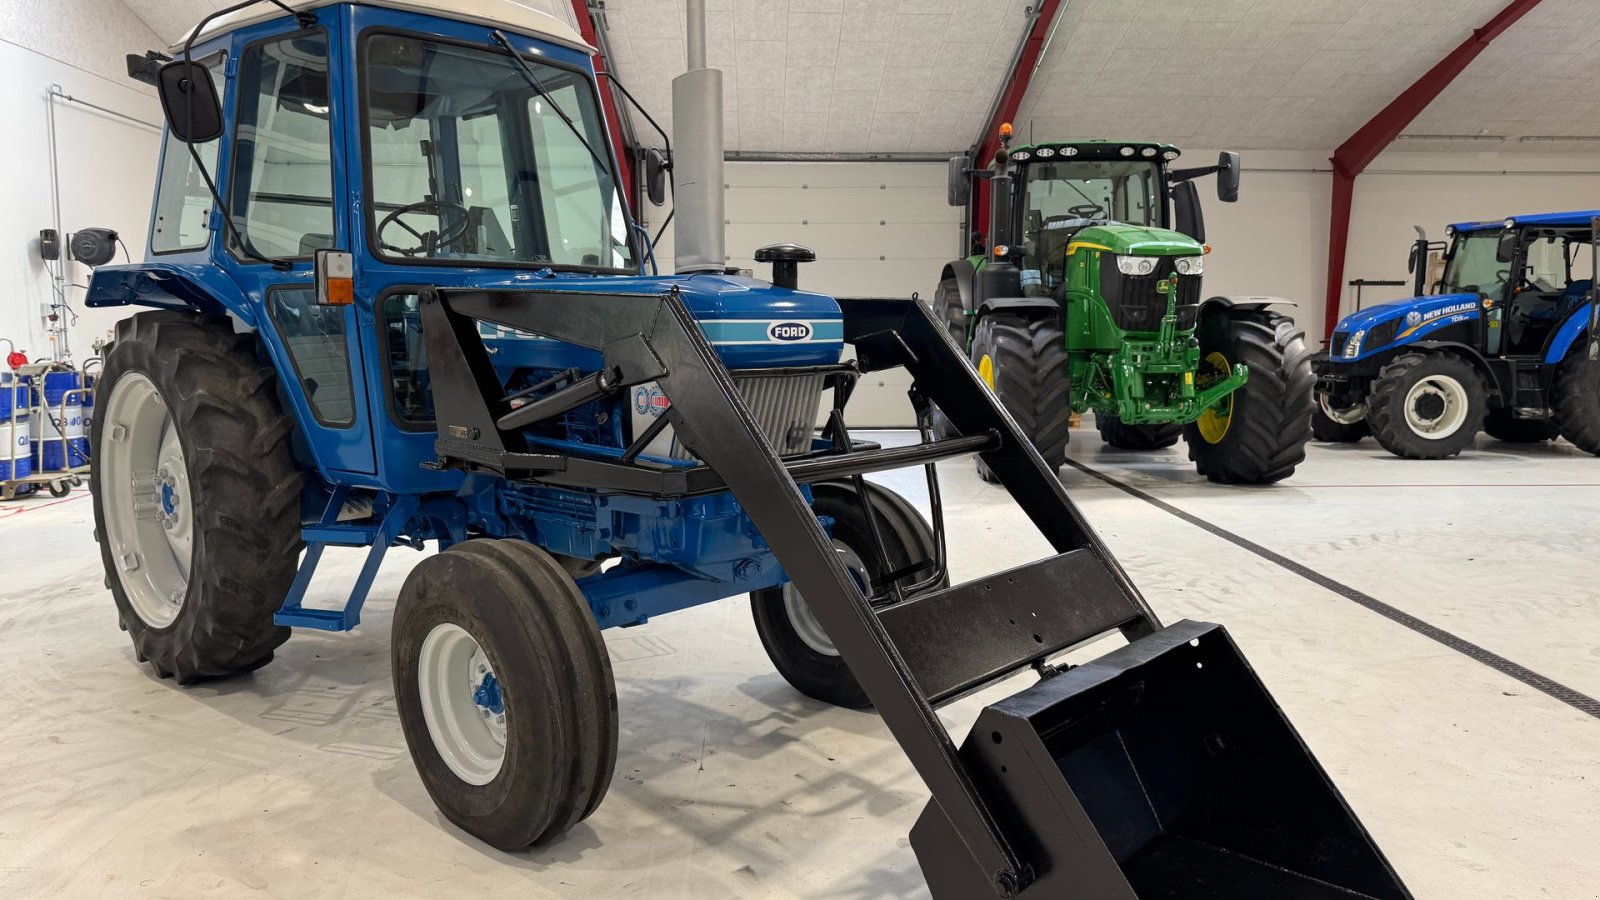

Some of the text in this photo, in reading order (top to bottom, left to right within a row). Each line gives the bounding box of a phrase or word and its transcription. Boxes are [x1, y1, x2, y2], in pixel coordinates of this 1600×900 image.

[1424, 303, 1476, 320] NEW HOLLAND
[775, 327, 806, 337] FORD
[18, 435, 29, 446] Q8
